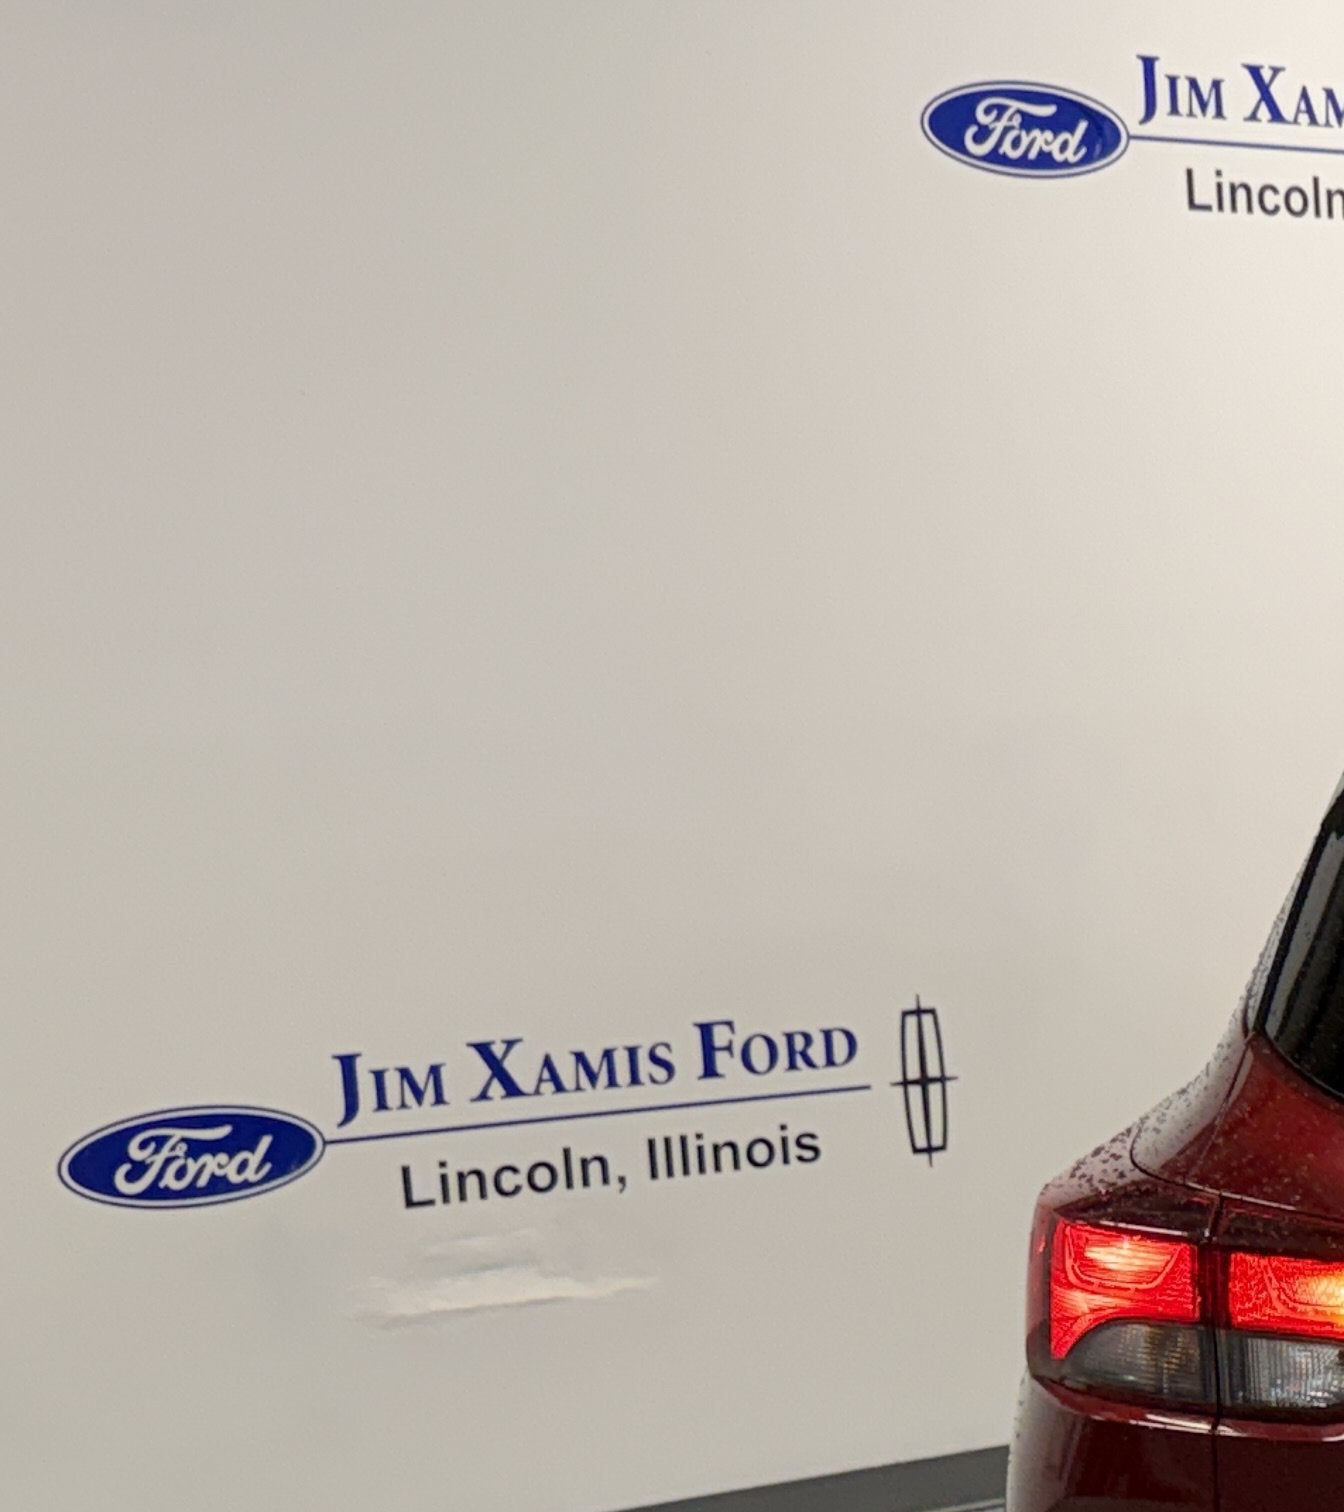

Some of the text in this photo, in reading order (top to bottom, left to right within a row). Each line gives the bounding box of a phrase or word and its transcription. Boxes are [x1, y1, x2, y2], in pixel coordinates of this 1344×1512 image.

[1136, 54, 1226, 126] JIM
[964, 97, 1087, 164] Ford
[332, 1020, 858, 1127] JIM XAMIS FORD
[115, 1124, 272, 1193] Ford
[401, 1124, 821, 1209] Lincoln, Illinois
